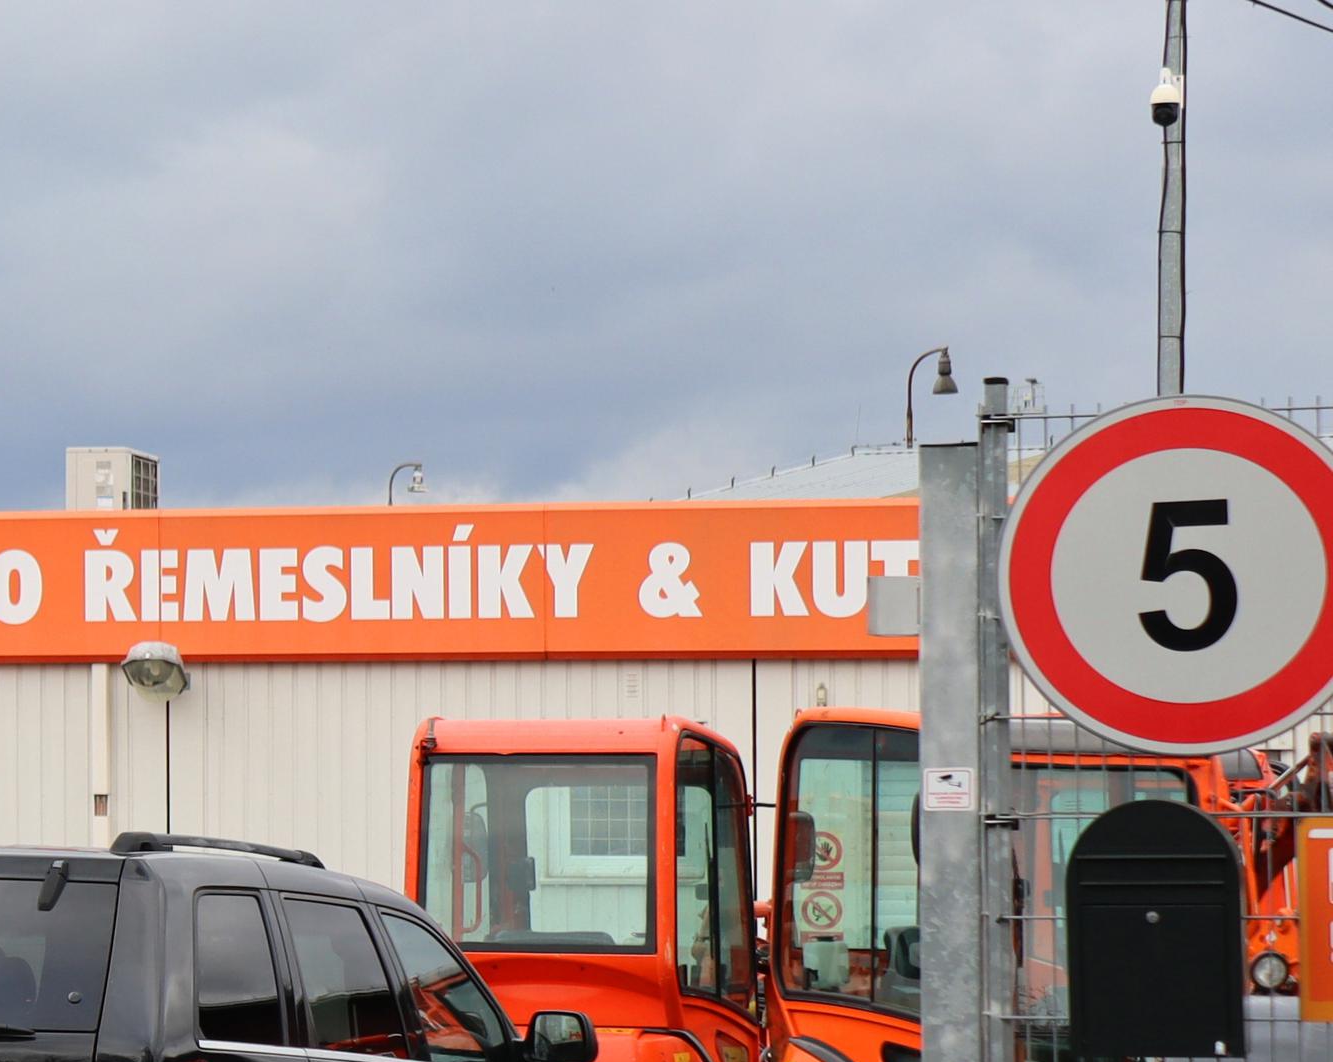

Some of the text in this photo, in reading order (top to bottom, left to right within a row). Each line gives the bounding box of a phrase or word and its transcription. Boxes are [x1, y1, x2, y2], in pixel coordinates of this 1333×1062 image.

[84, 523, 594, 623] ŘEMESLNÍKY
[639, 542, 703, 618] &
[1138, 498, 1238, 652] 5
